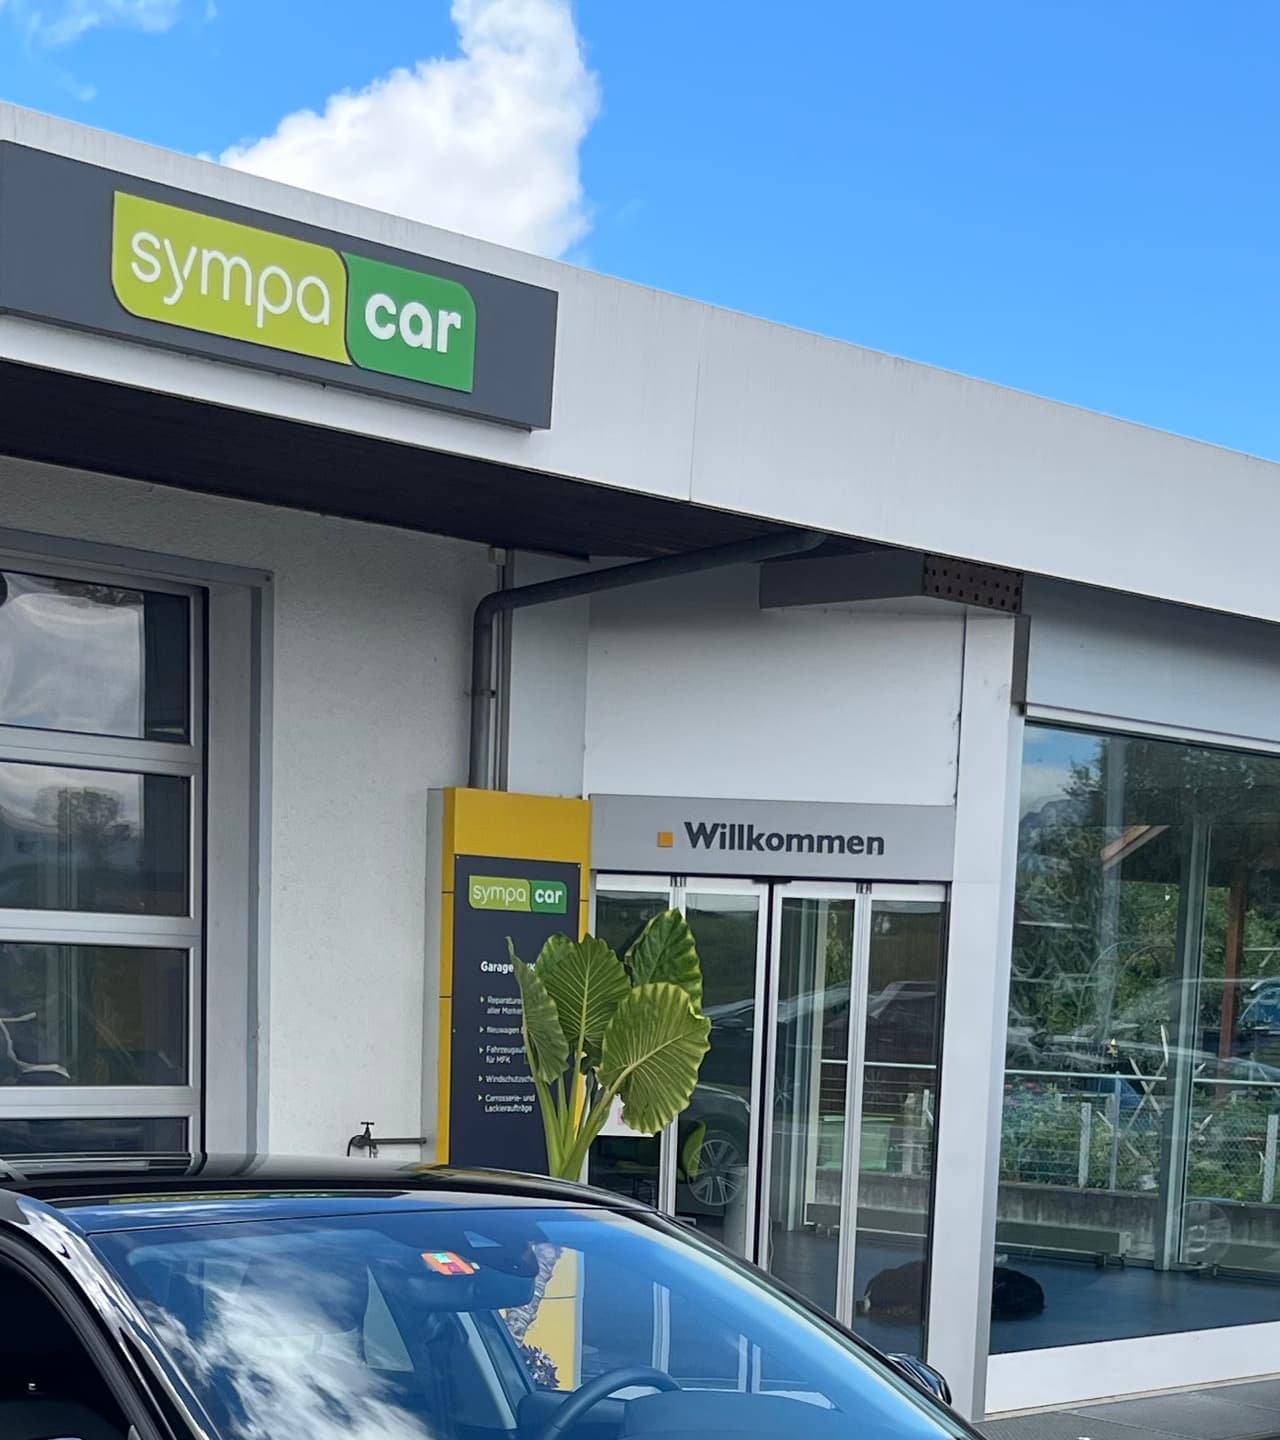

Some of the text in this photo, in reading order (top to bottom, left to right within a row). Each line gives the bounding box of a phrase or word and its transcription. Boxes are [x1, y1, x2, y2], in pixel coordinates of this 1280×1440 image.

[129, 230, 462, 354] sympa car
[684, 821, 885, 856] Willkommen
[473, 884, 563, 905] sympa car
[480, 961, 514, 974] Garage
